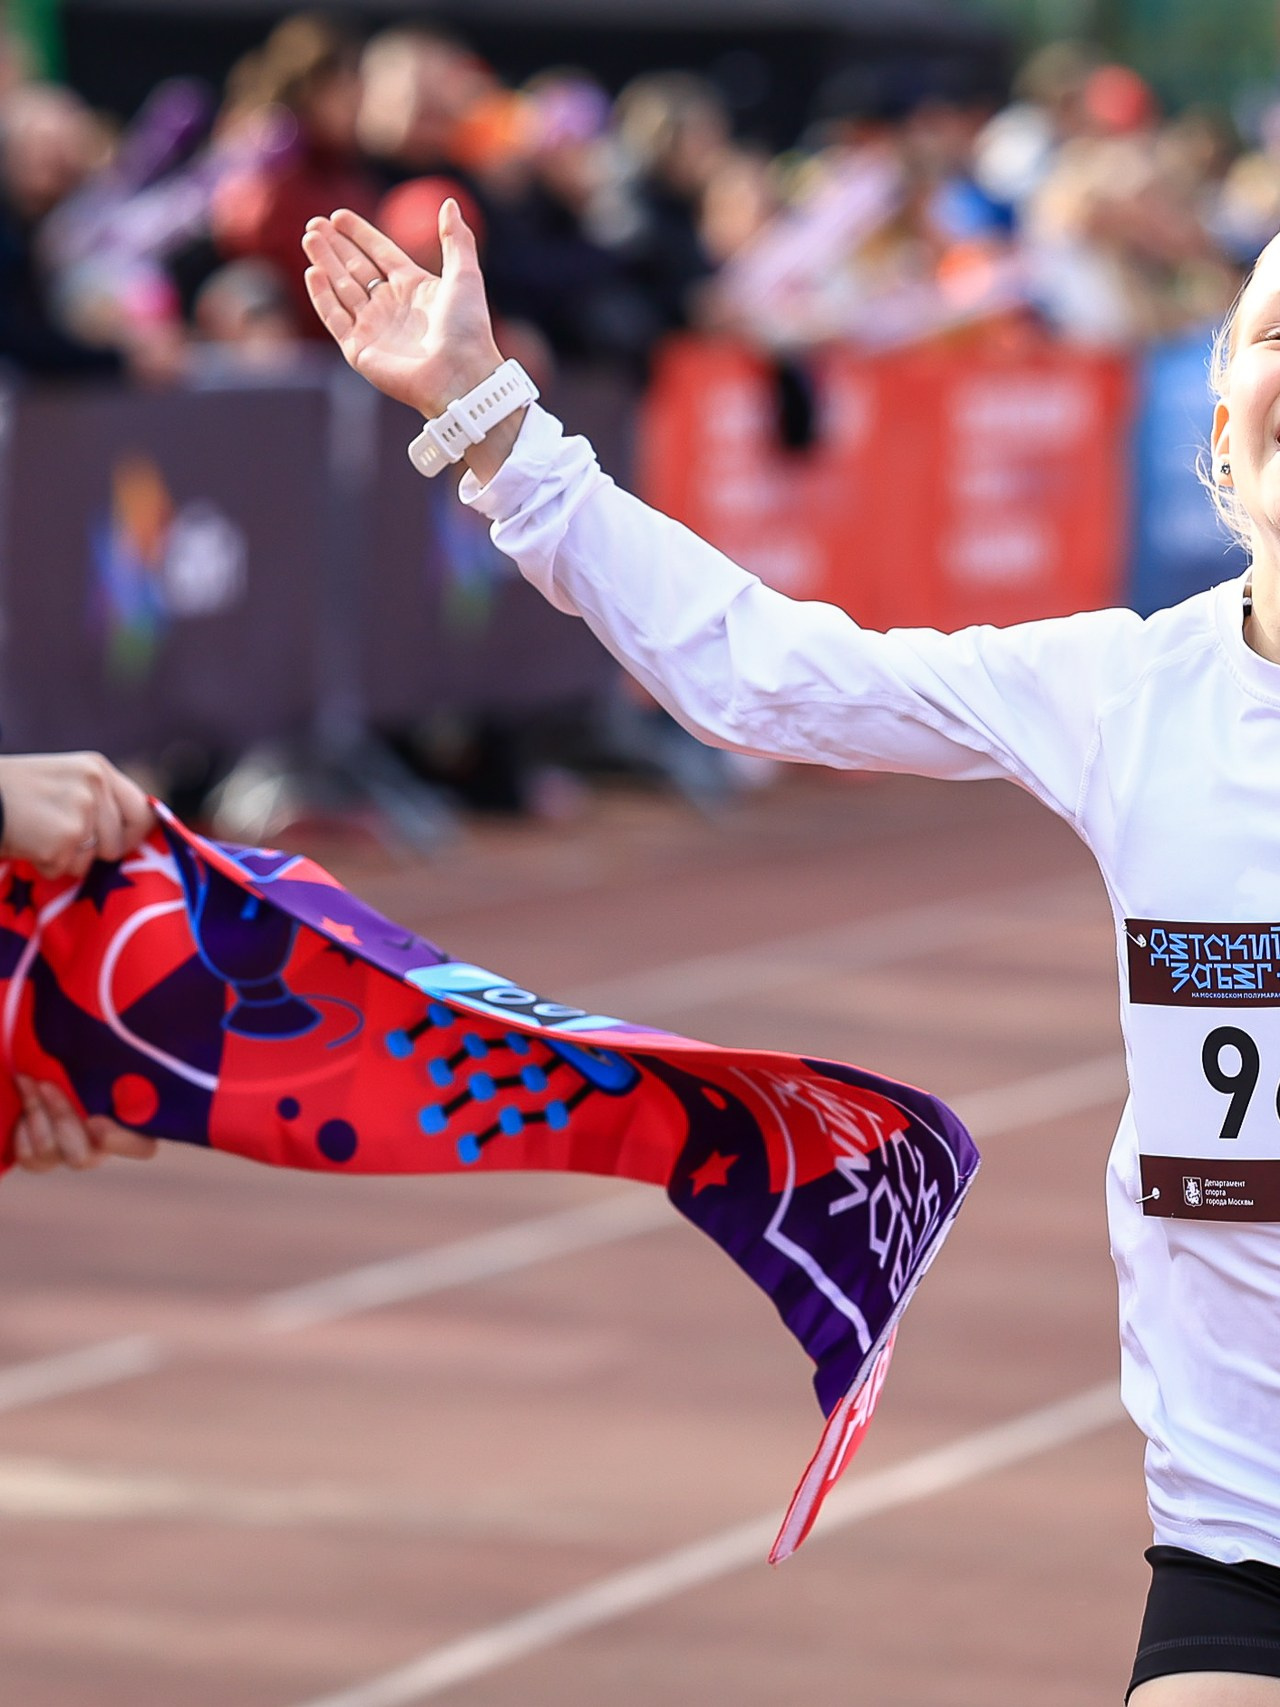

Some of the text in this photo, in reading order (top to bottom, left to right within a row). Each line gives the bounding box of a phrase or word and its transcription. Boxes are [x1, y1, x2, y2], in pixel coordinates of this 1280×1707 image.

[1204, 1178, 1246, 1188] Департамент
[1205, 1189, 1226, 1197] спорта
[1205, 1198, 1254, 1206] города Москвы
